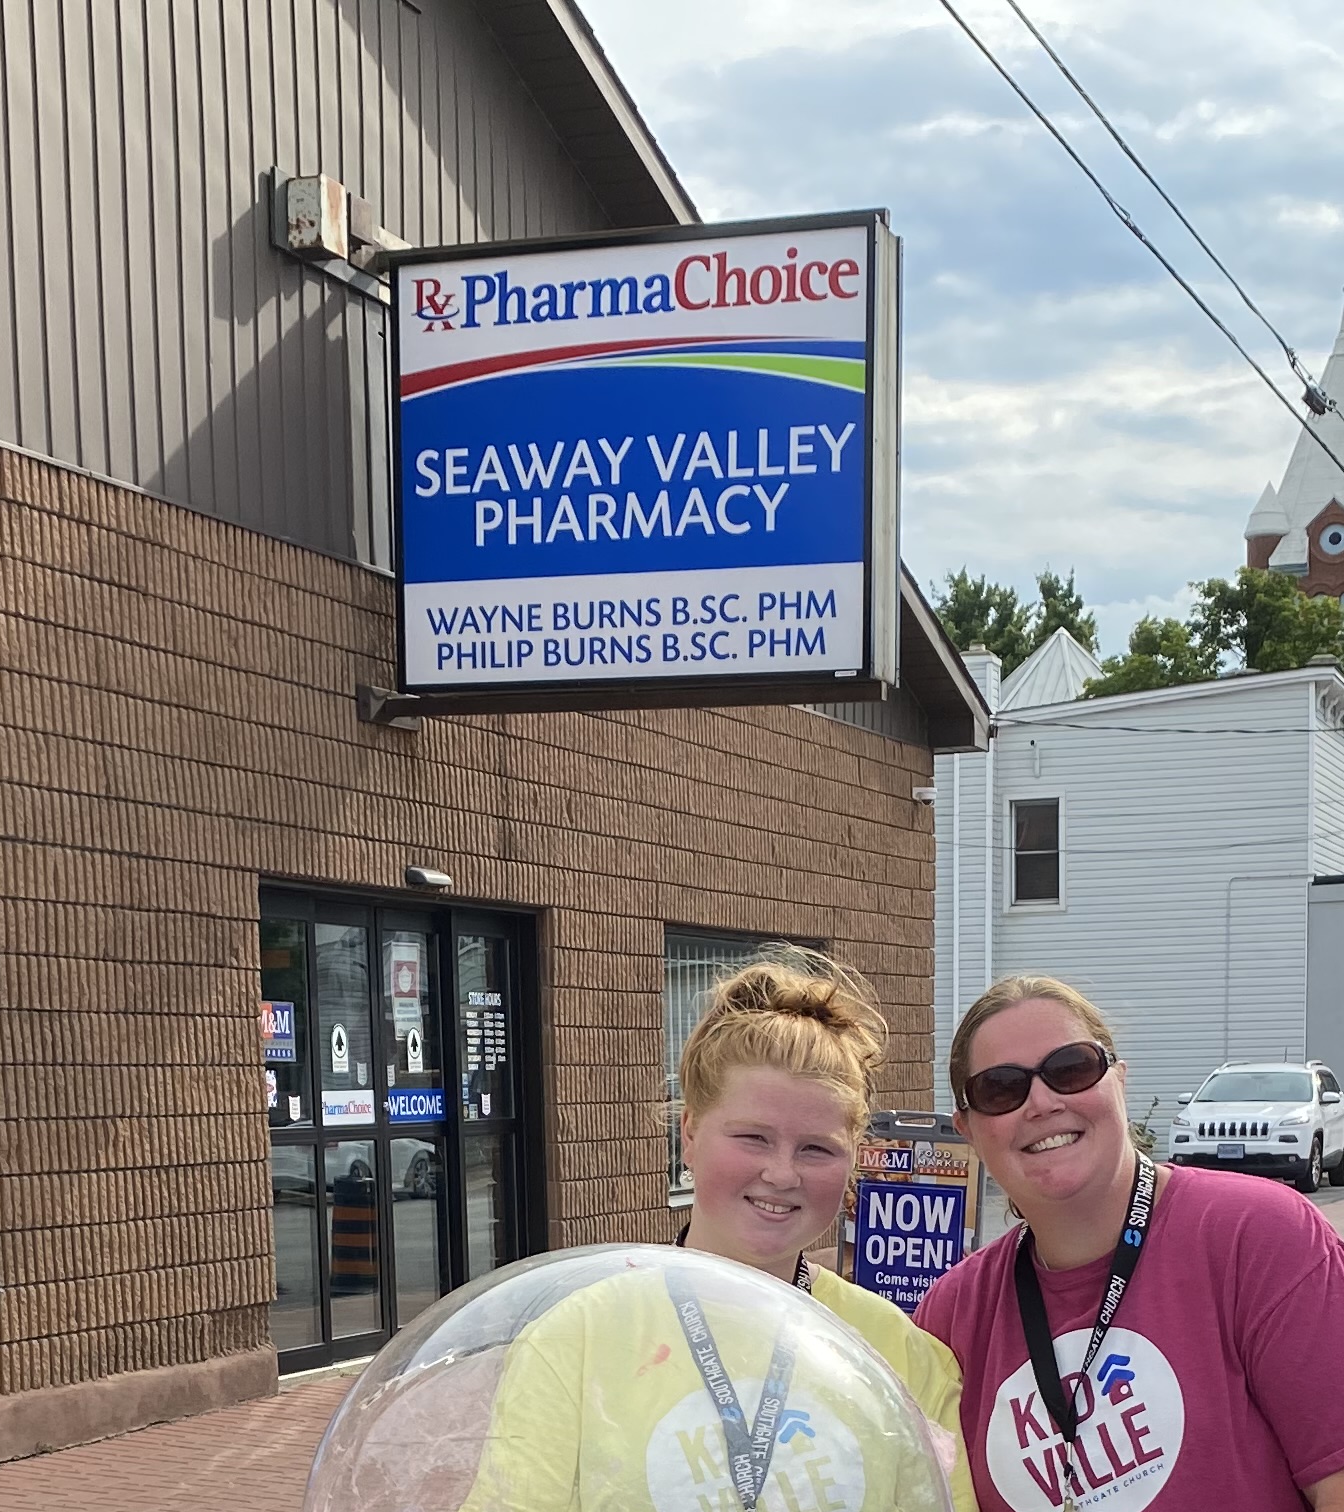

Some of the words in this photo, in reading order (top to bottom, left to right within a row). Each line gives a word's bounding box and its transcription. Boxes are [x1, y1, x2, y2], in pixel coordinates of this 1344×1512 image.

[460, 246, 860, 328] PharmaChoice
[414, 436, 635, 497] SEAWAY
[646, 422, 857, 482] VALLEY
[474, 482, 791, 547] PHARMACY
[426, 602, 543, 637] WAYNE
[554, 597, 663, 632] BURNS
[670, 593, 749, 627] B.SC.
[759, 589, 838, 622] PHM
[437, 640, 534, 671] PHILIP
[543, 634, 653, 668] BURNS
[661, 630, 739, 663] B.SC.
[748, 626, 827, 657] PHM
[388, 1095, 443, 1116] WELCOME
[859, 1150, 909, 1169] M&M
[917, 1158, 968, 1168] MARKET
[918, 1149, 952, 1160] FOOD
[868, 1191, 955, 1234] NOW
[865, 1234, 954, 1270] OPEN!
[875, 1271, 909, 1287] Come
[896, 1288, 925, 1303] Insid
[1100, 1275, 1126, 1325] CHURCH
[679, 1301, 707, 1343] CHURCH
[696, 1343, 735, 1405] SOUTHGATE
[751, 1397, 781, 1460] SOUTHGATE
[1022, 1402, 1165, 1508] VILLE
[1123, 1462, 1164, 1488] CHURCH
